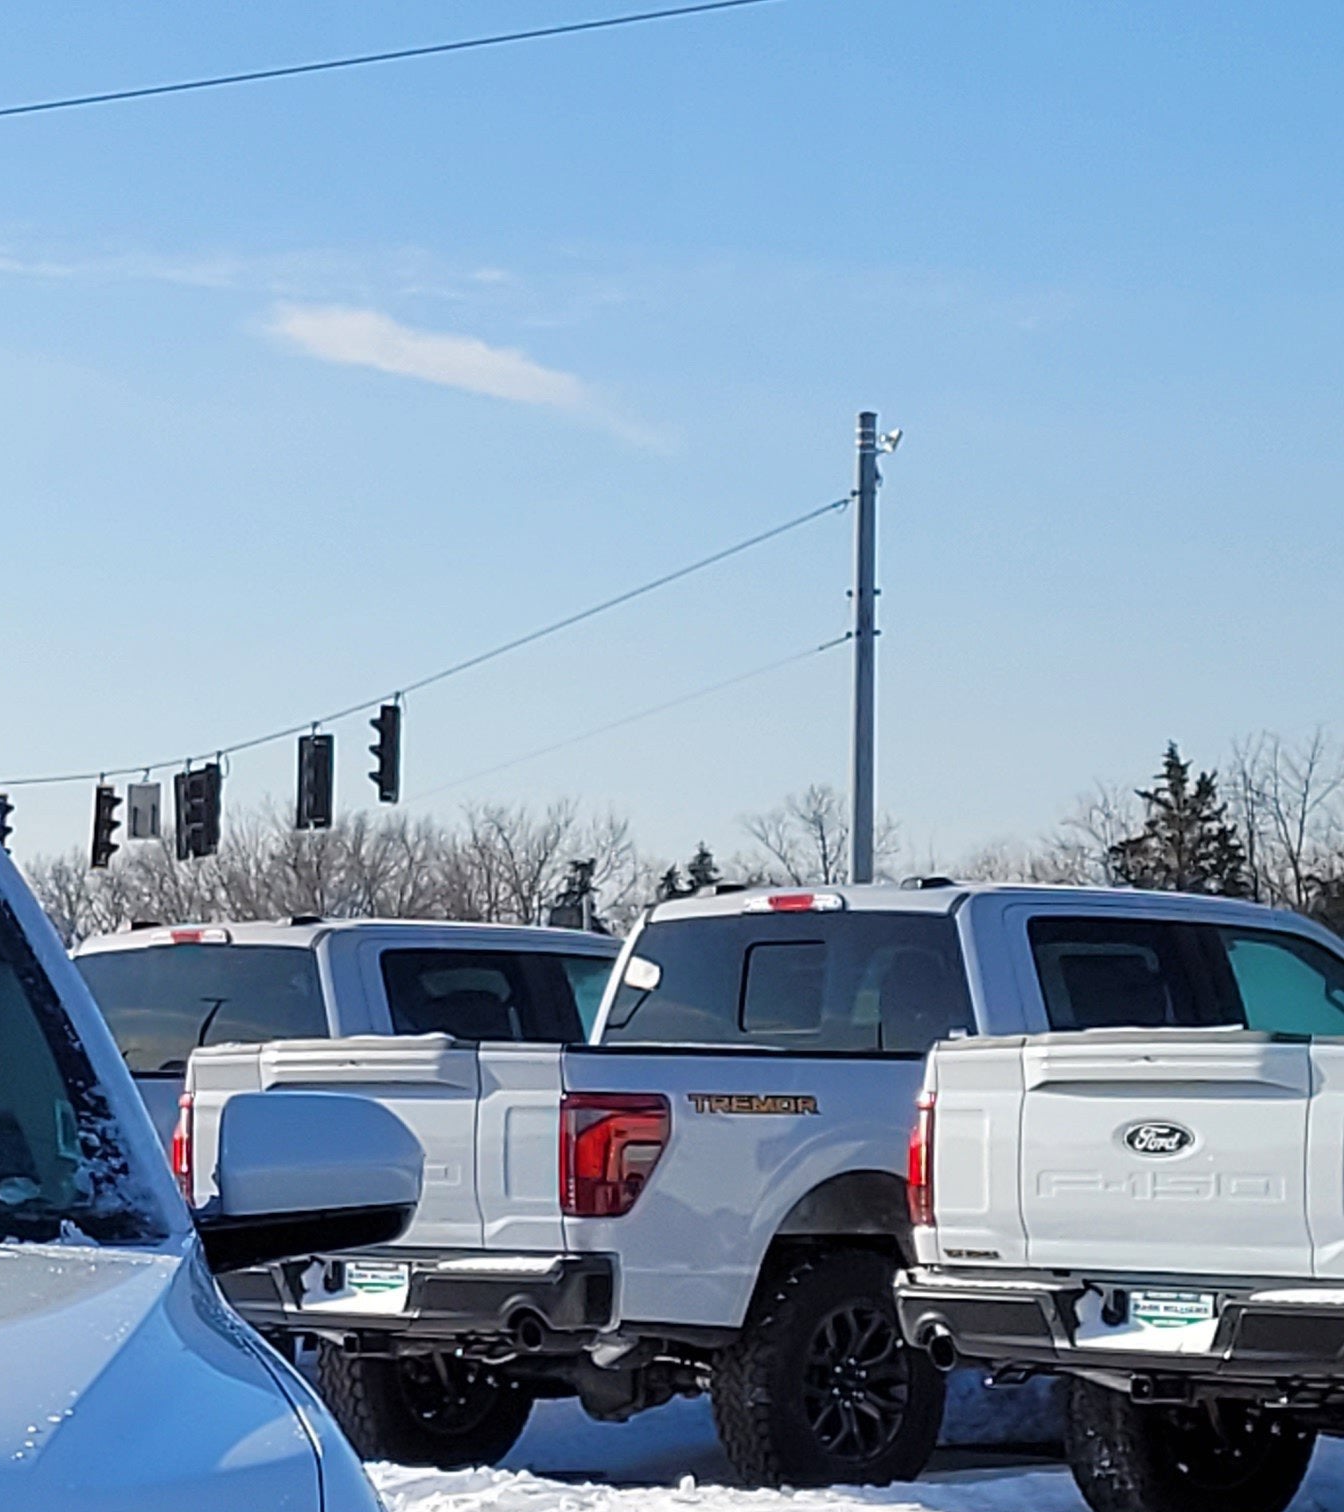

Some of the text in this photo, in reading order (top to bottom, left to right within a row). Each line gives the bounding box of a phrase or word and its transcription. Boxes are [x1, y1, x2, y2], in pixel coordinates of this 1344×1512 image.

[687, 1092, 822, 1116] TREMOR
[1133, 1125, 1181, 1151] Ford
[1036, 1169, 1287, 1201] F-150
